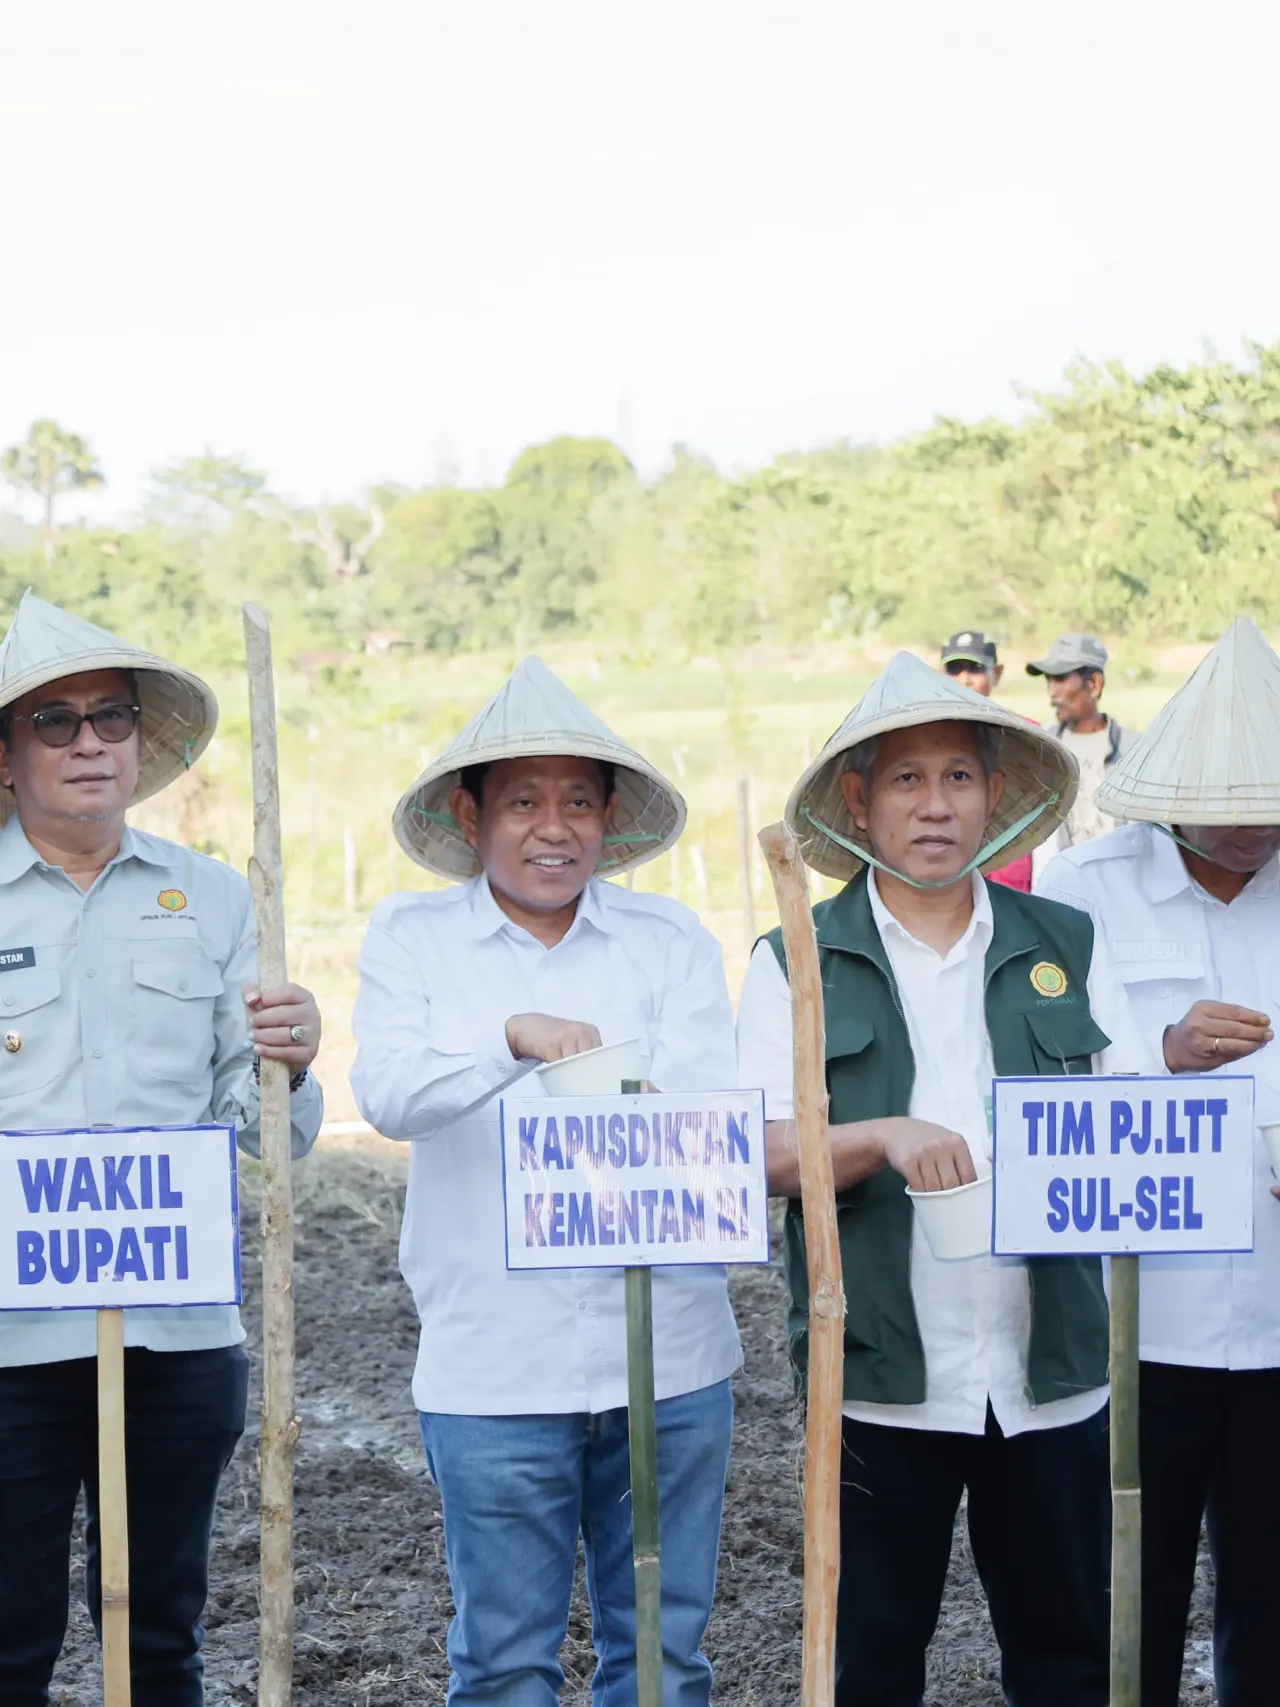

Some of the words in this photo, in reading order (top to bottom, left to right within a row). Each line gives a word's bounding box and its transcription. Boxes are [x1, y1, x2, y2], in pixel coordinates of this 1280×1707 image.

[518, 1110, 750, 1171] KAPUSDIKTAN
[1022, 1100, 1096, 1156] TIM
[1110, 1098, 1228, 1156] PJ.LTT
[16, 1153, 183, 1214] WAKIL
[1046, 1175, 1203, 1234] SUL-SEL
[523, 1188, 706, 1248] KEMENTAN
[16, 1225, 189, 1286] BUPATI
